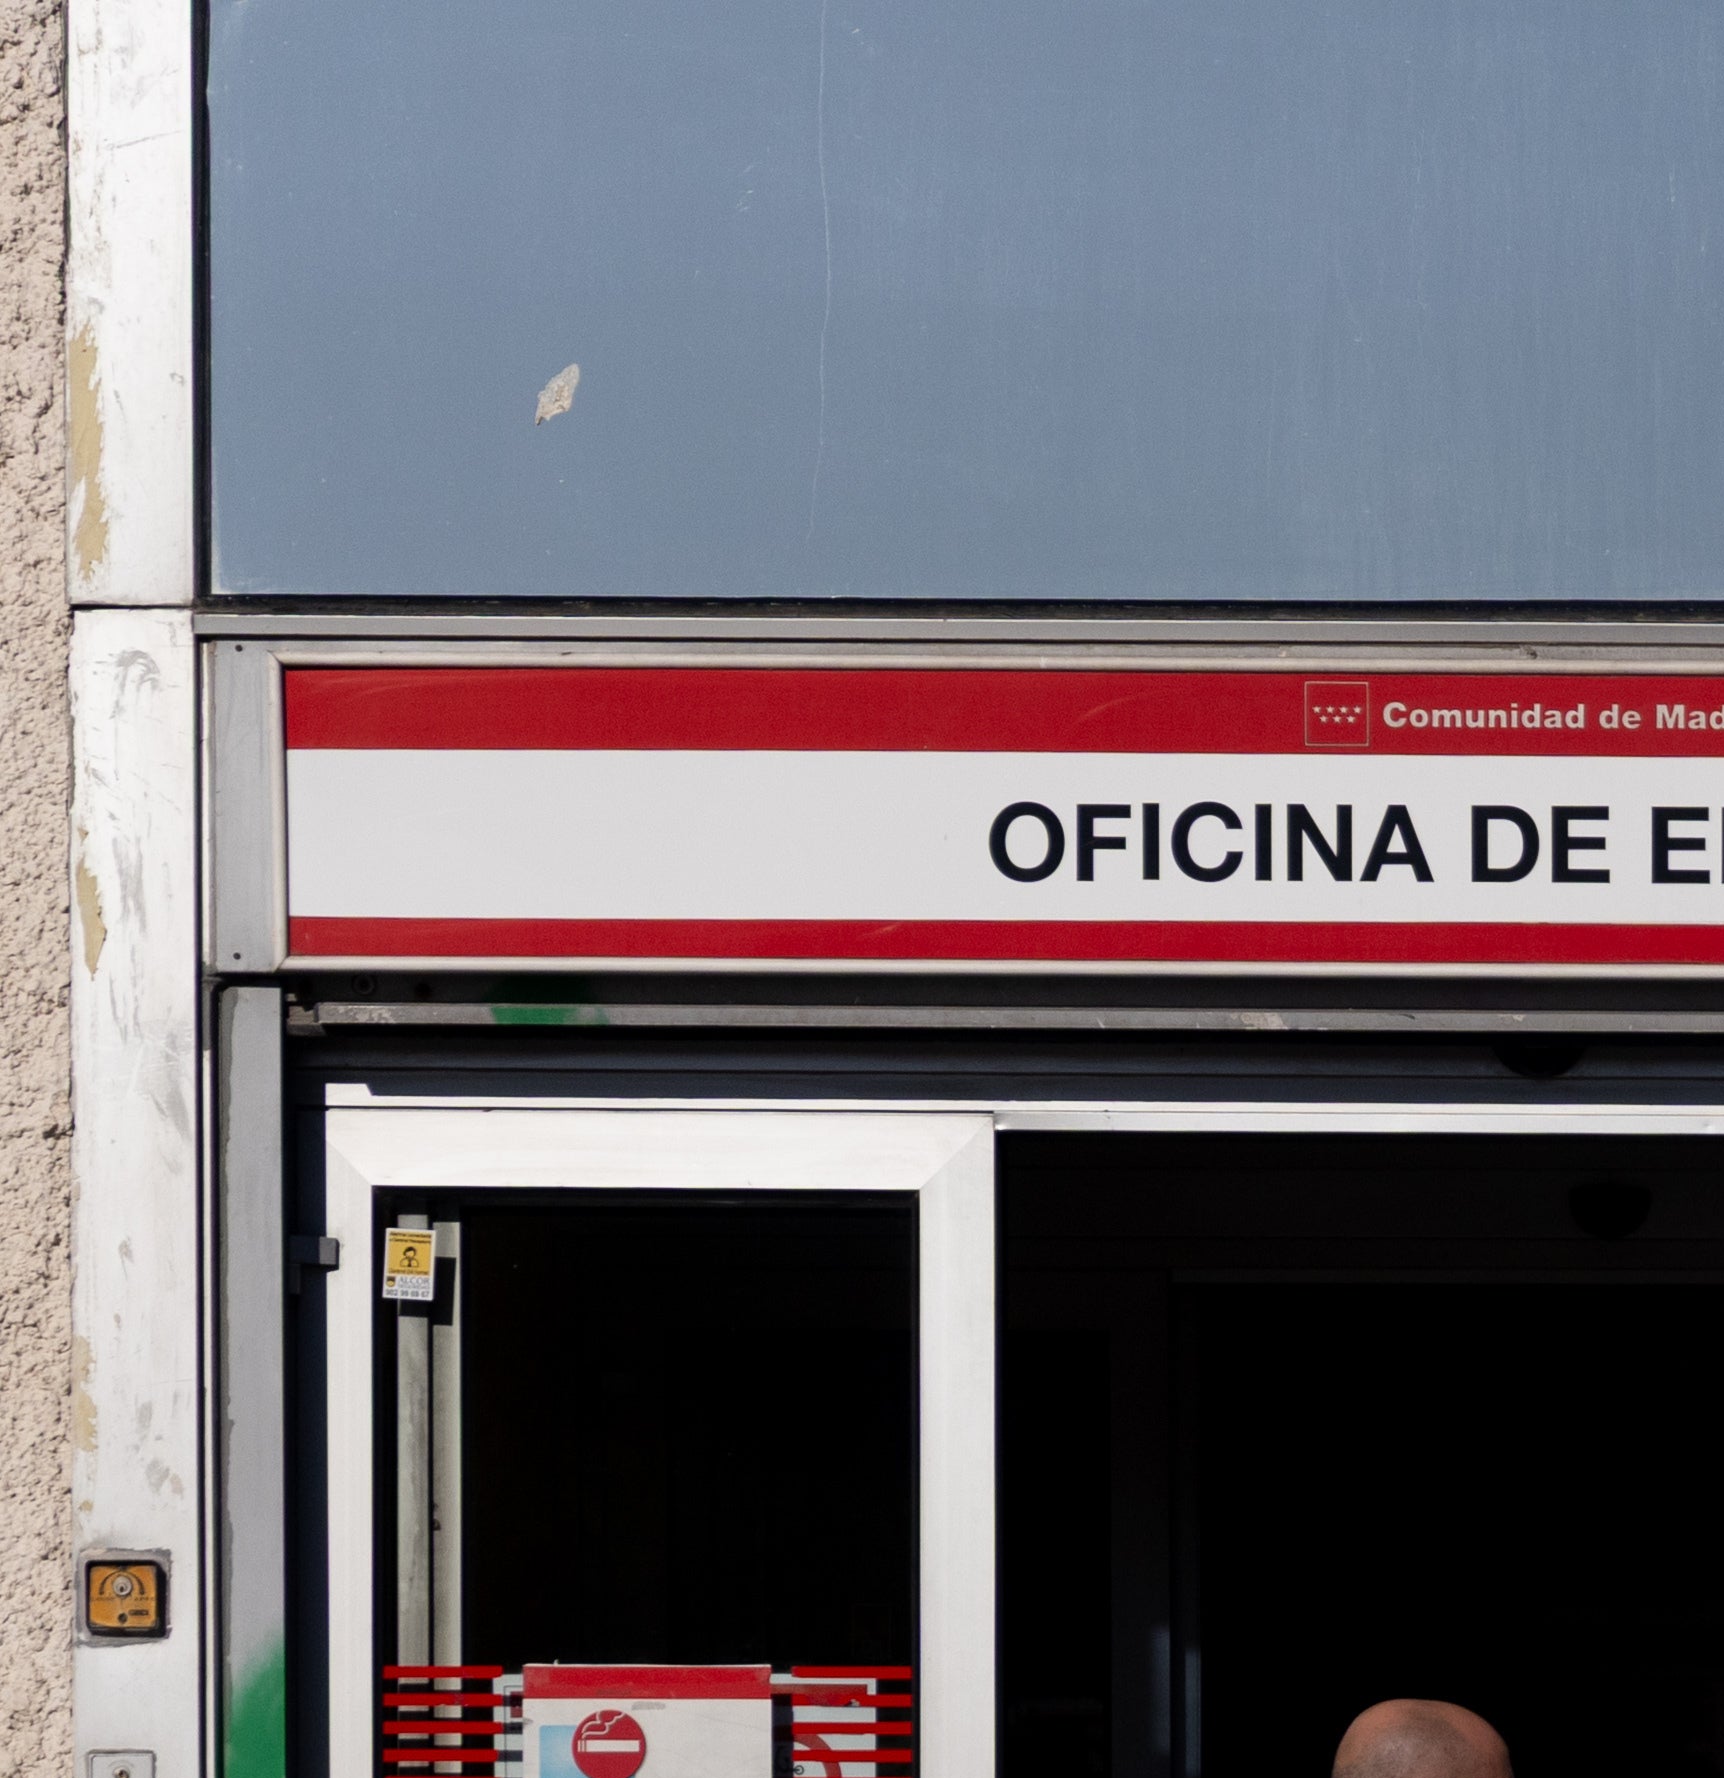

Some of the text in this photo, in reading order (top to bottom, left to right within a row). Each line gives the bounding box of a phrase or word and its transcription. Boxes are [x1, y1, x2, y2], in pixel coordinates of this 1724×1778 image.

[1382, 701, 1587, 731] Comunidad
[1599, 703, 1642, 730] de
[989, 802, 1434, 882] OFICINA
[1472, 805, 1610, 883] DE
